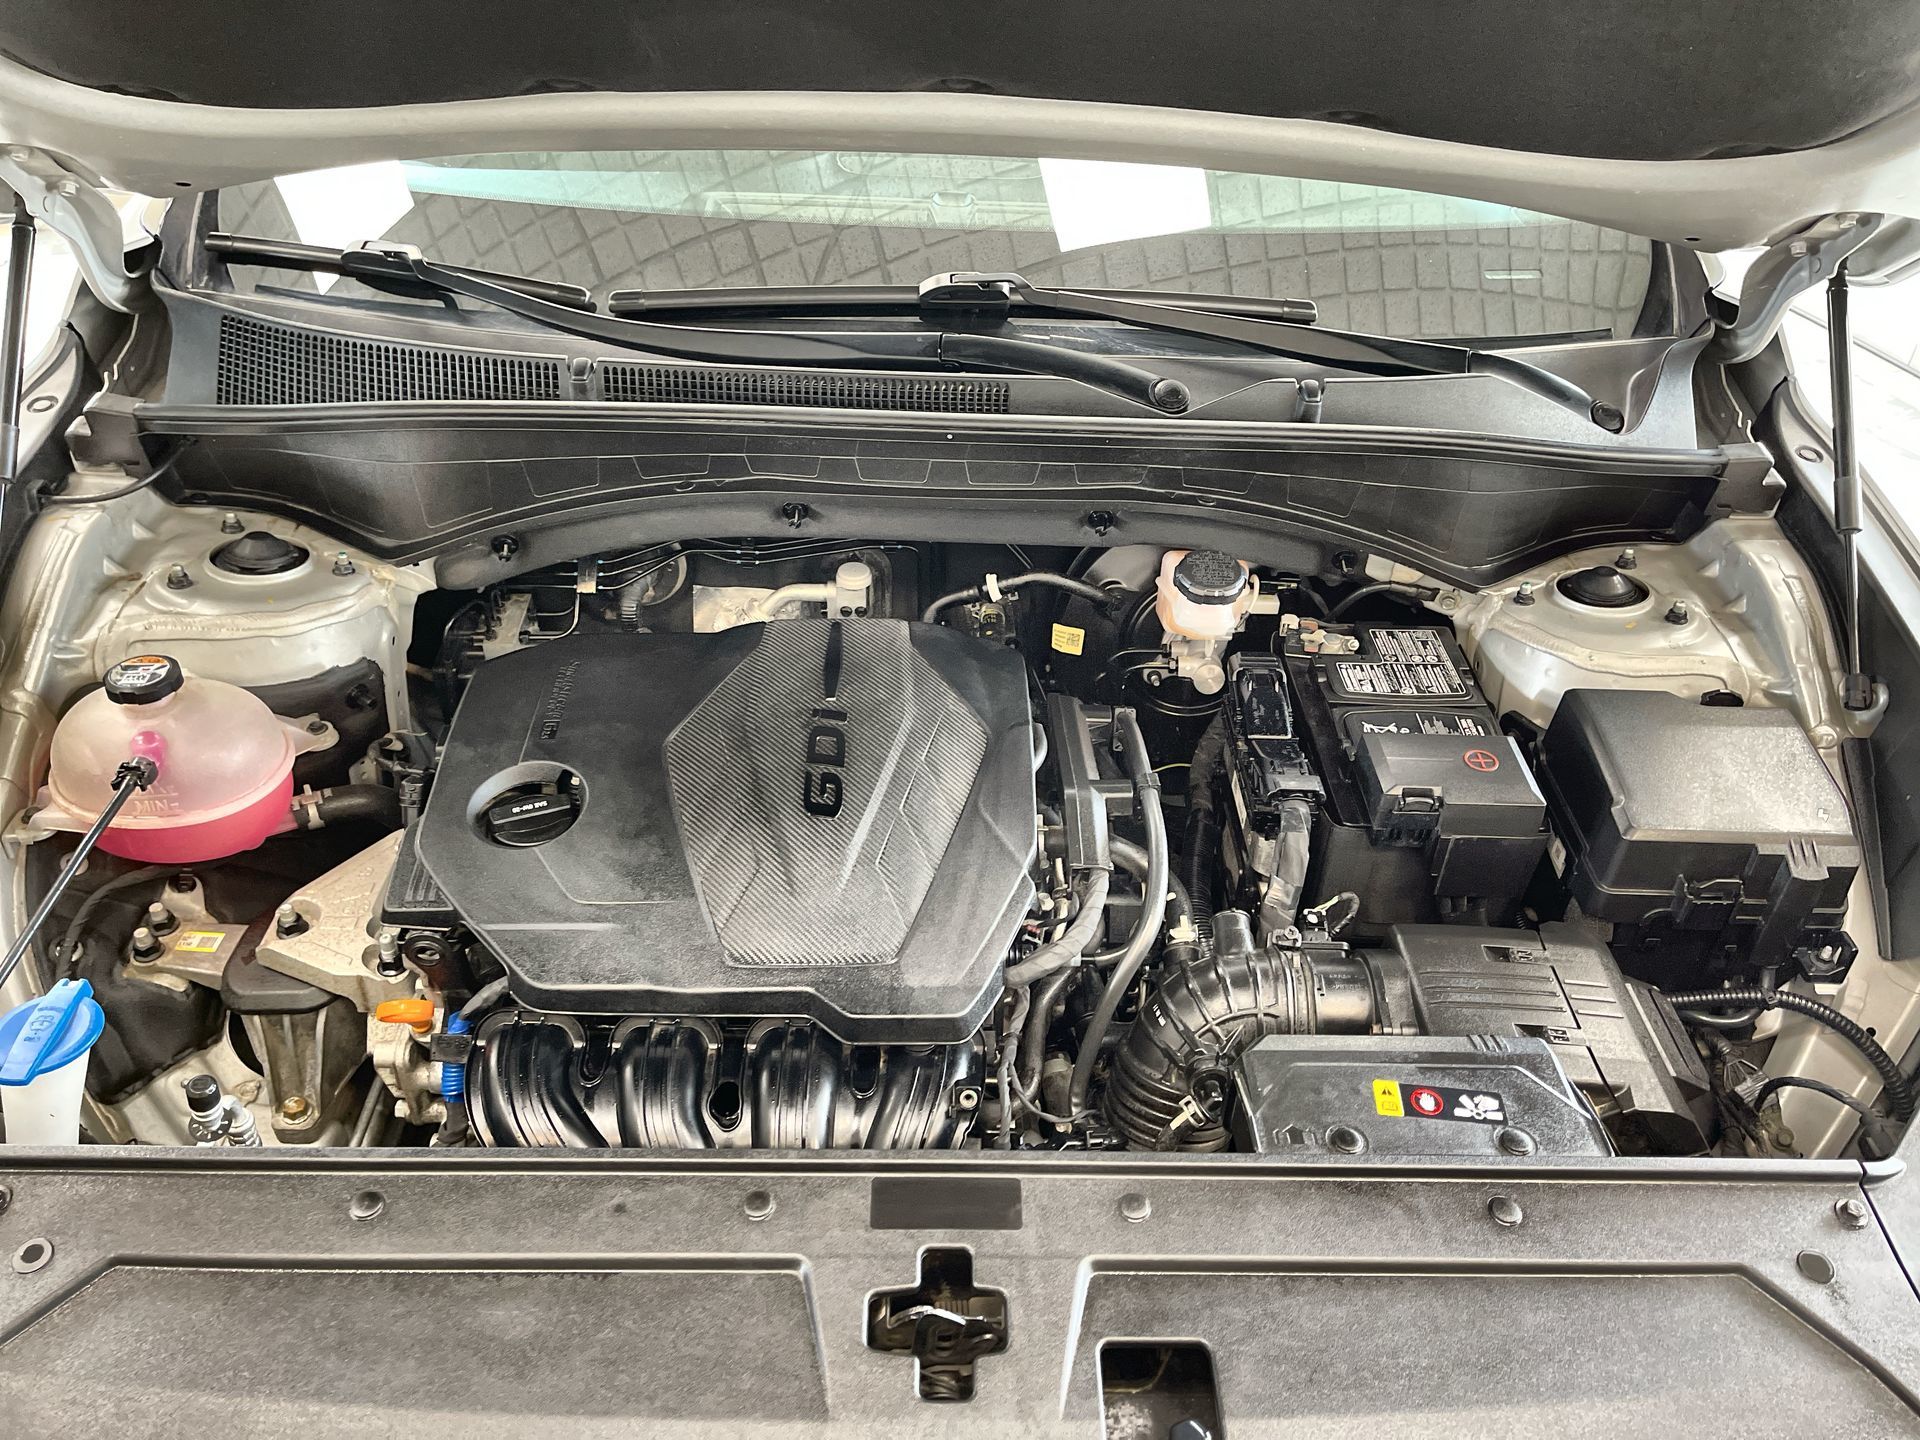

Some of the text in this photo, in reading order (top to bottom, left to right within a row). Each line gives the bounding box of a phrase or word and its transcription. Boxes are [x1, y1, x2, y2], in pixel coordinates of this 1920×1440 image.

[803, 708, 848, 819] GDI
[511, 800, 548, 814] SAE 0W-20
